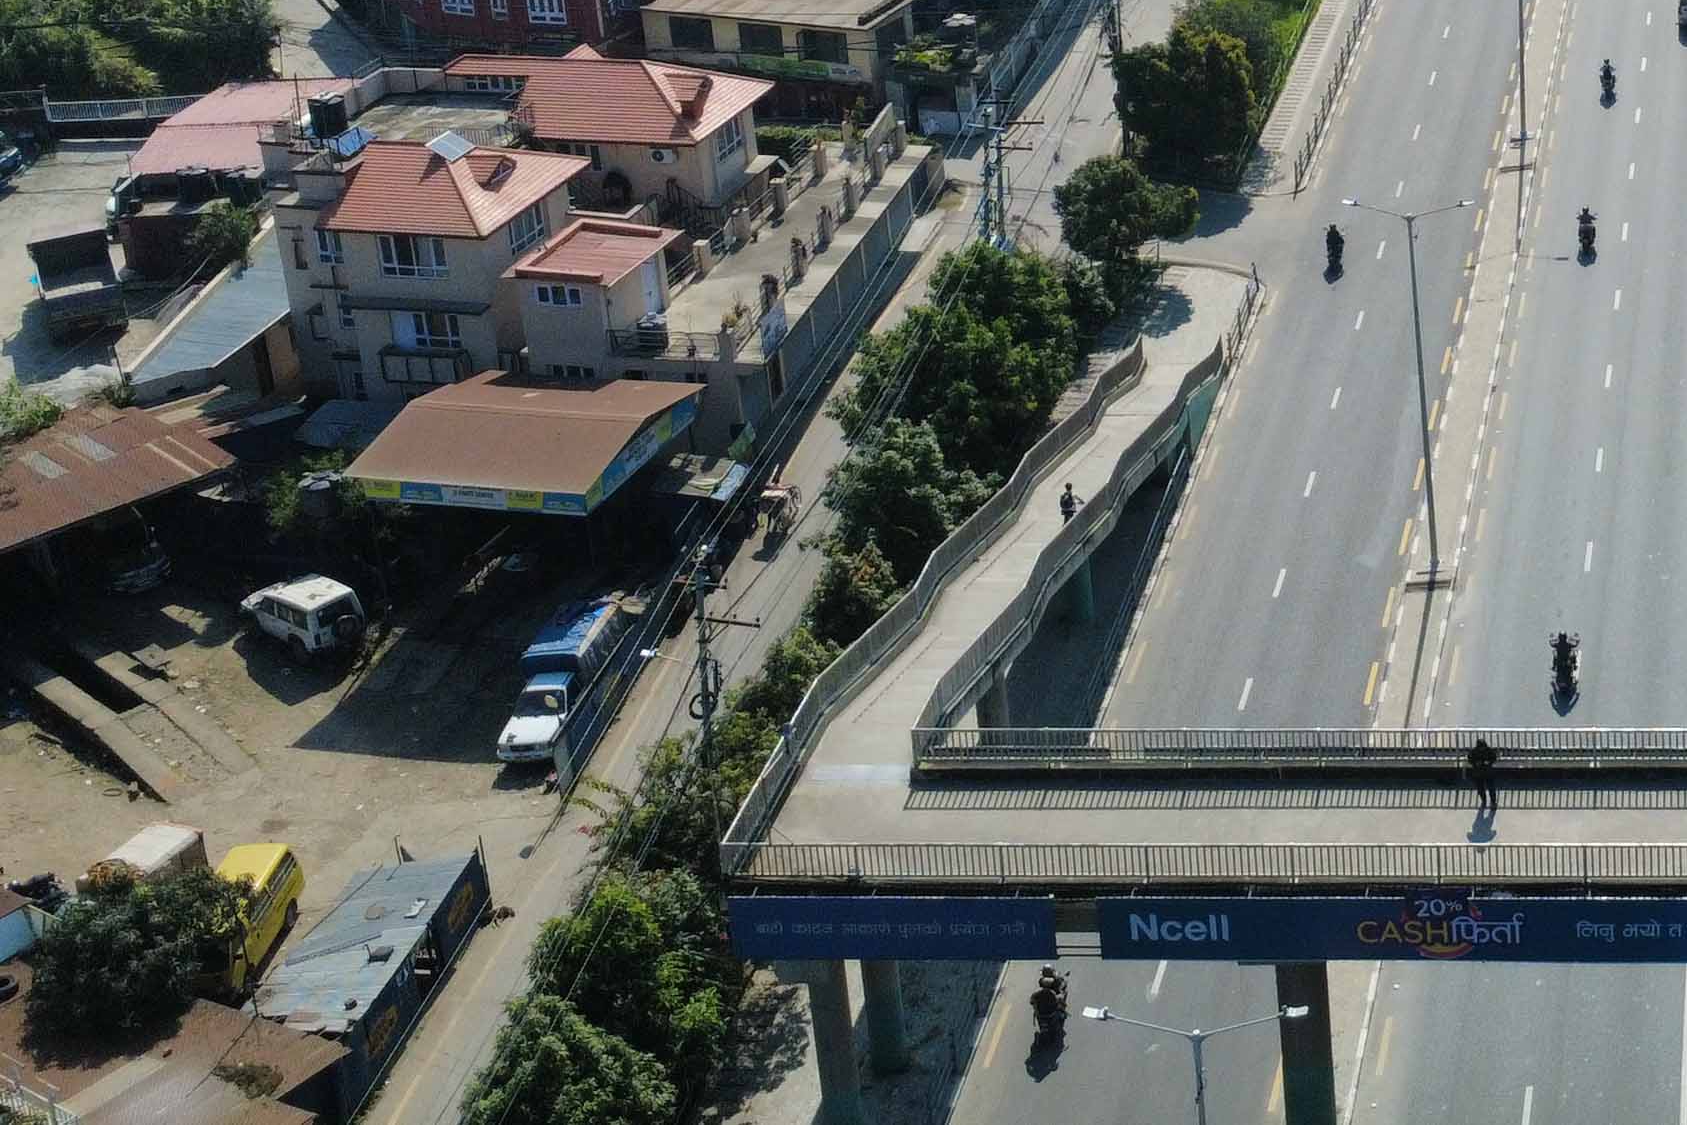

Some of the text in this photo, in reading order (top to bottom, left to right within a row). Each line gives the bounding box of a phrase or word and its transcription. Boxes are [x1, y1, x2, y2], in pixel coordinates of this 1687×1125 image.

[1414, 898, 1464, 917] 20%
[1128, 913, 1230, 941] Ncell
[1622, 917, 1662, 938] भयो
